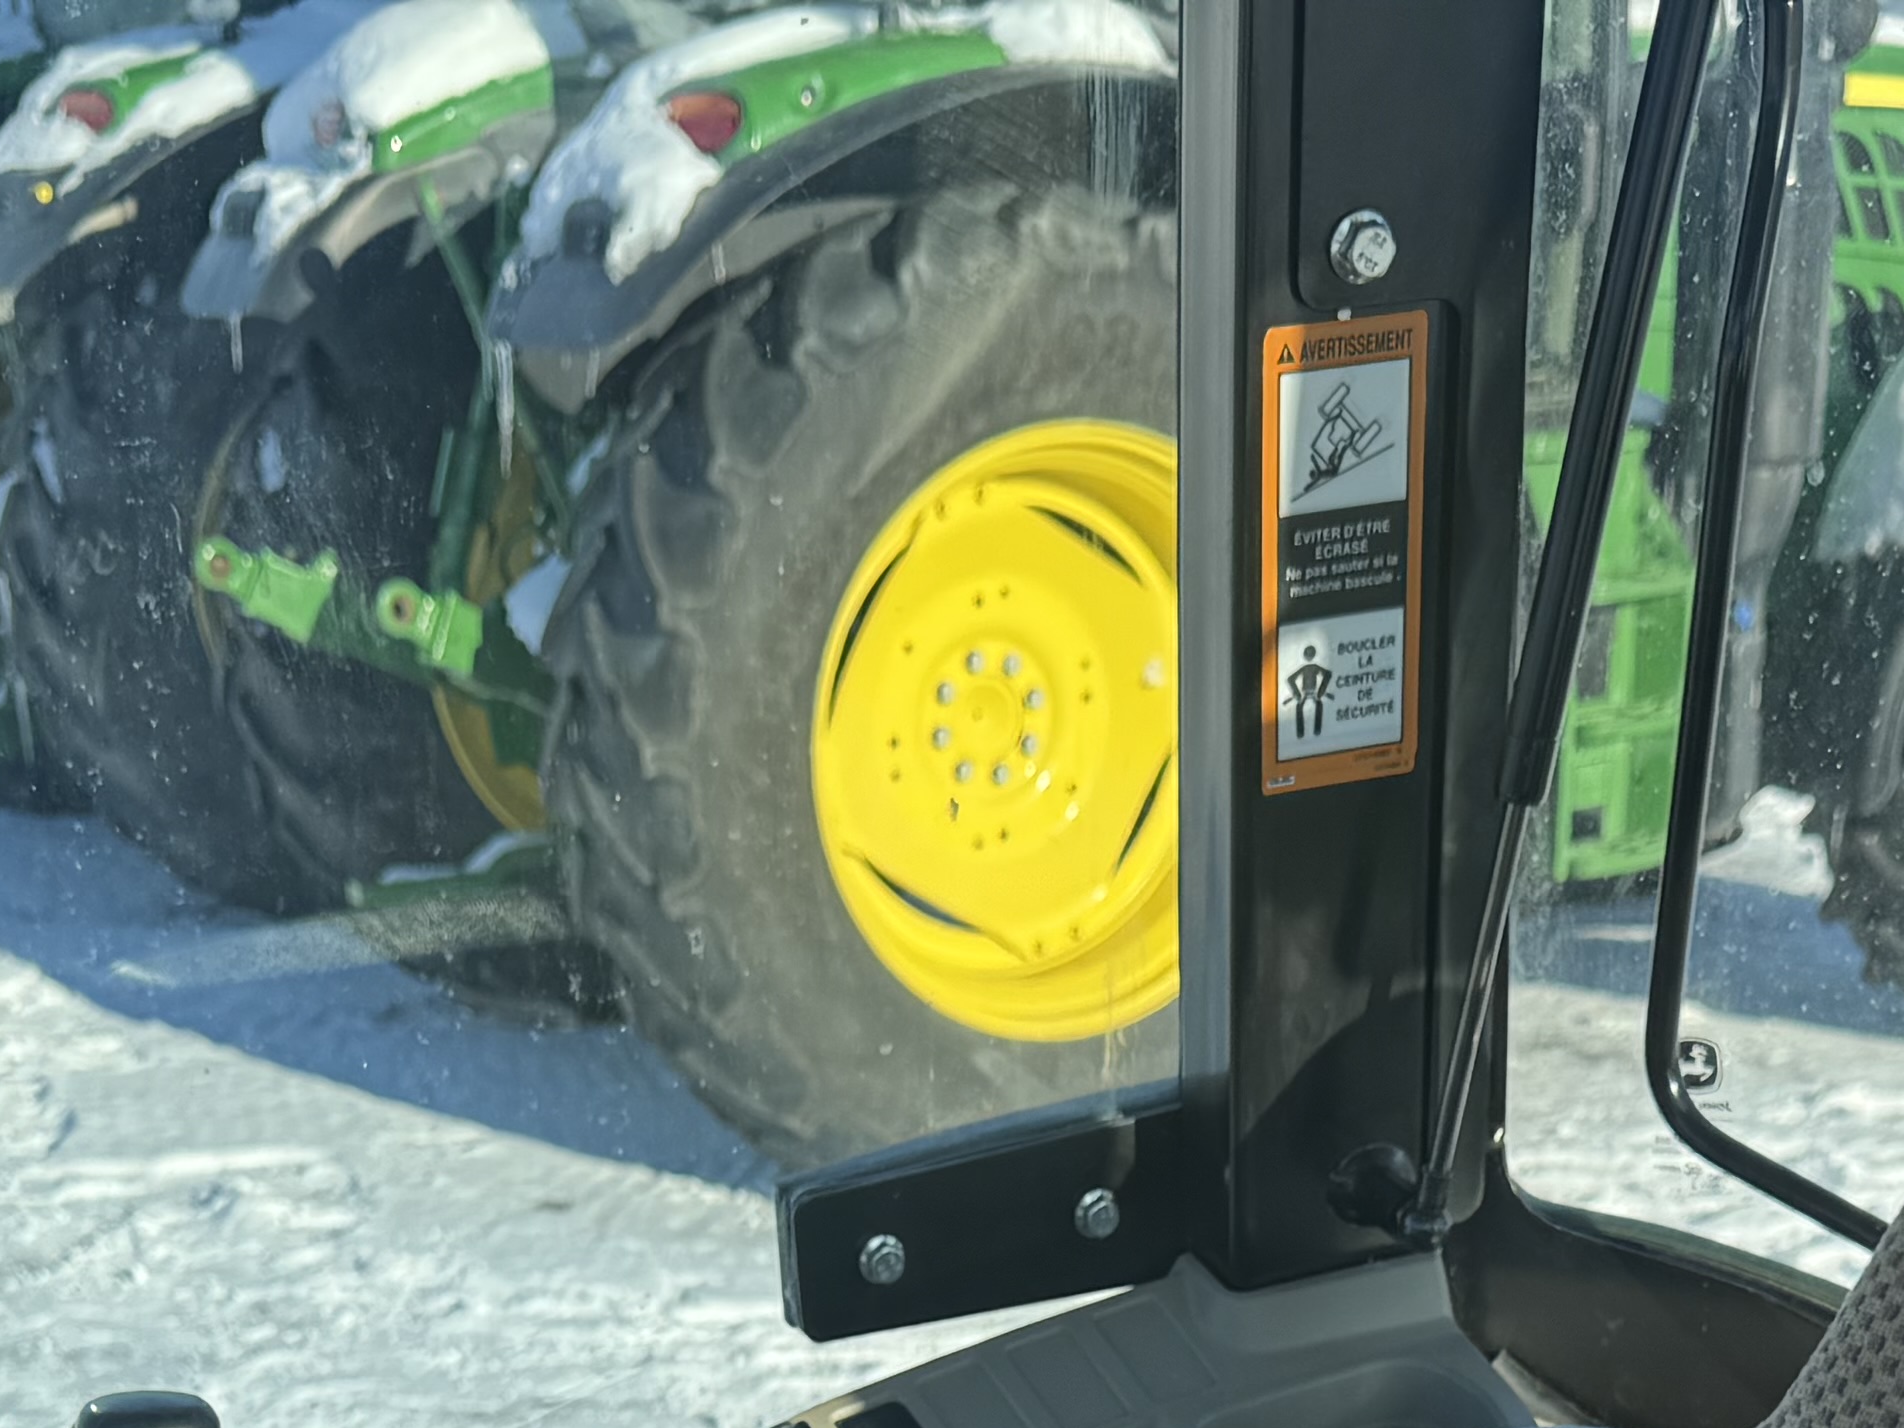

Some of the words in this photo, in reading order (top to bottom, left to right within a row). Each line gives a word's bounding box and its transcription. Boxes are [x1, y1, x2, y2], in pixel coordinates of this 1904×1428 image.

[1300, 328, 1414, 364] AVERTISSEMENT
[1294, 524, 1341, 546] ÉVITER
[1315, 538, 1368, 560] ÉCRASÉ
[1285, 566, 1302, 582] Ne
[1305, 565, 1328, 581] pas
[1331, 557, 1370, 575] sauter
[1373, 553, 1384, 569] si
[1387, 553, 1398, 567] la
[1290, 580, 1342, 598] machine
[1337, 634, 1396, 656] BOUCLER
[1358, 654, 1373, 669] LA
[1335, 668, 1396, 689] CEINTURE
[1357, 688, 1373, 702] DE
[1335, 699, 1394, 722] SÉCURITÉ
